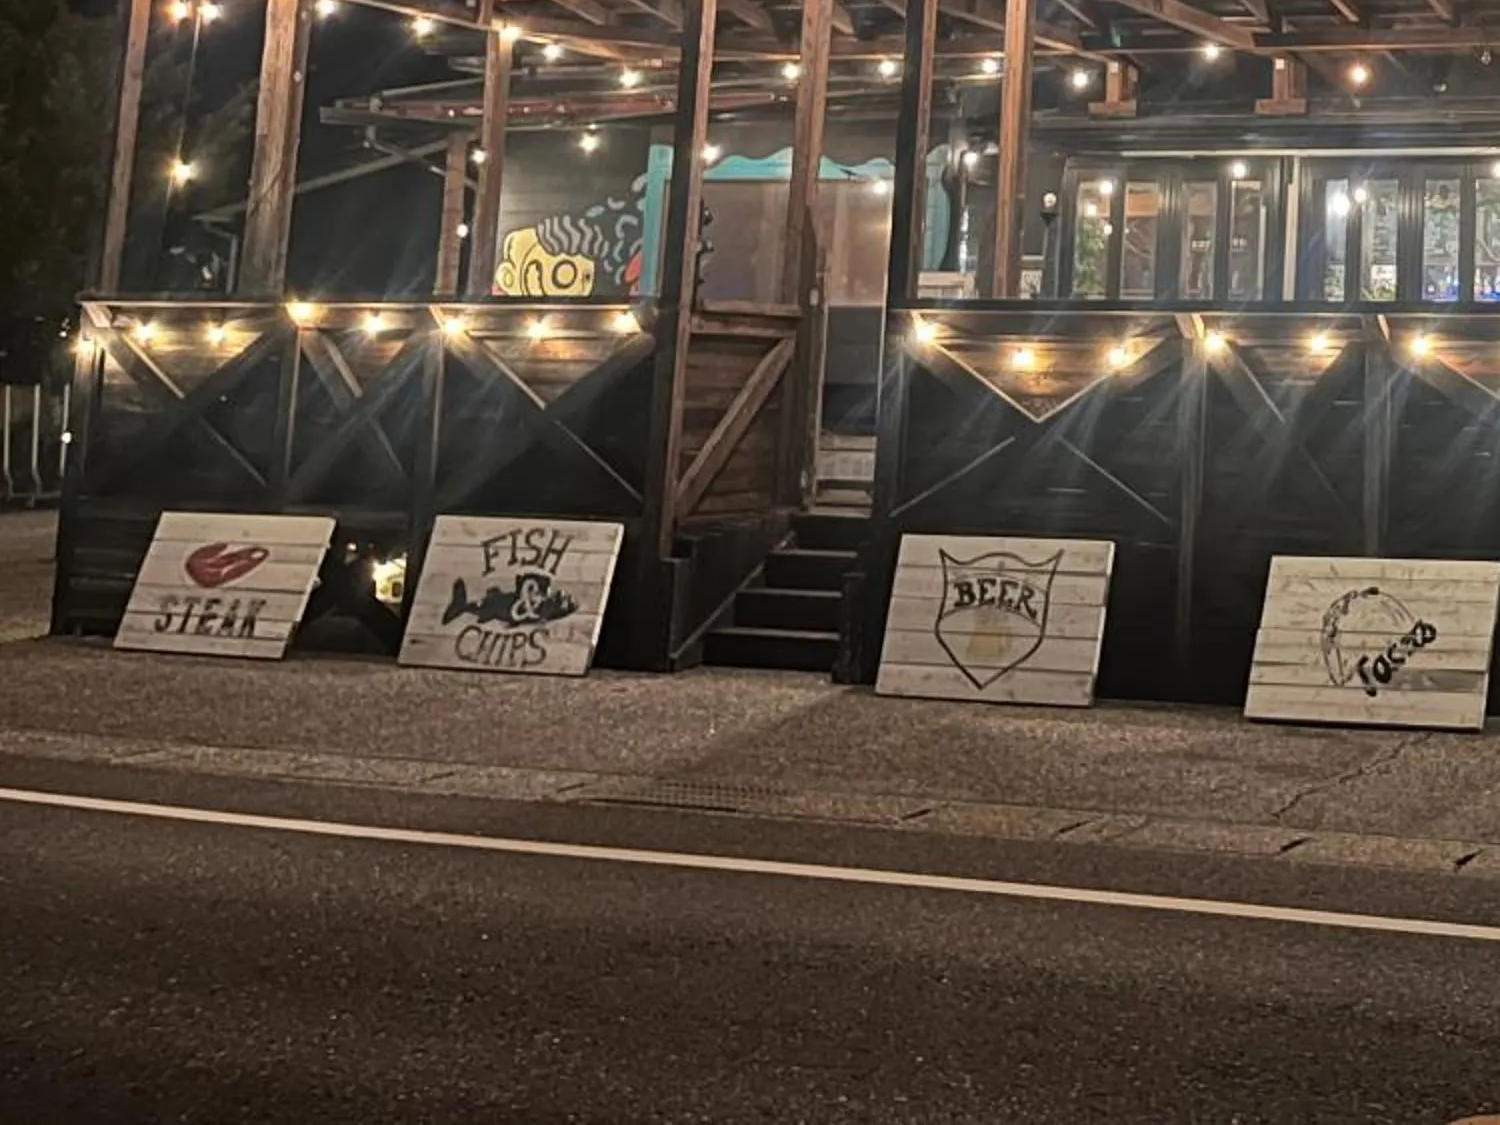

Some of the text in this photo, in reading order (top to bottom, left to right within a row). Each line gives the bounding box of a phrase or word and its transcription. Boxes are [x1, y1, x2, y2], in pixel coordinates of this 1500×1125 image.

[480, 526, 576, 575] FISH
[153, 594, 268, 639] STEAK
[511, 578, 544, 621] &
[953, 576, 1039, 618] BEER
[454, 627, 551, 667] CHIPS
